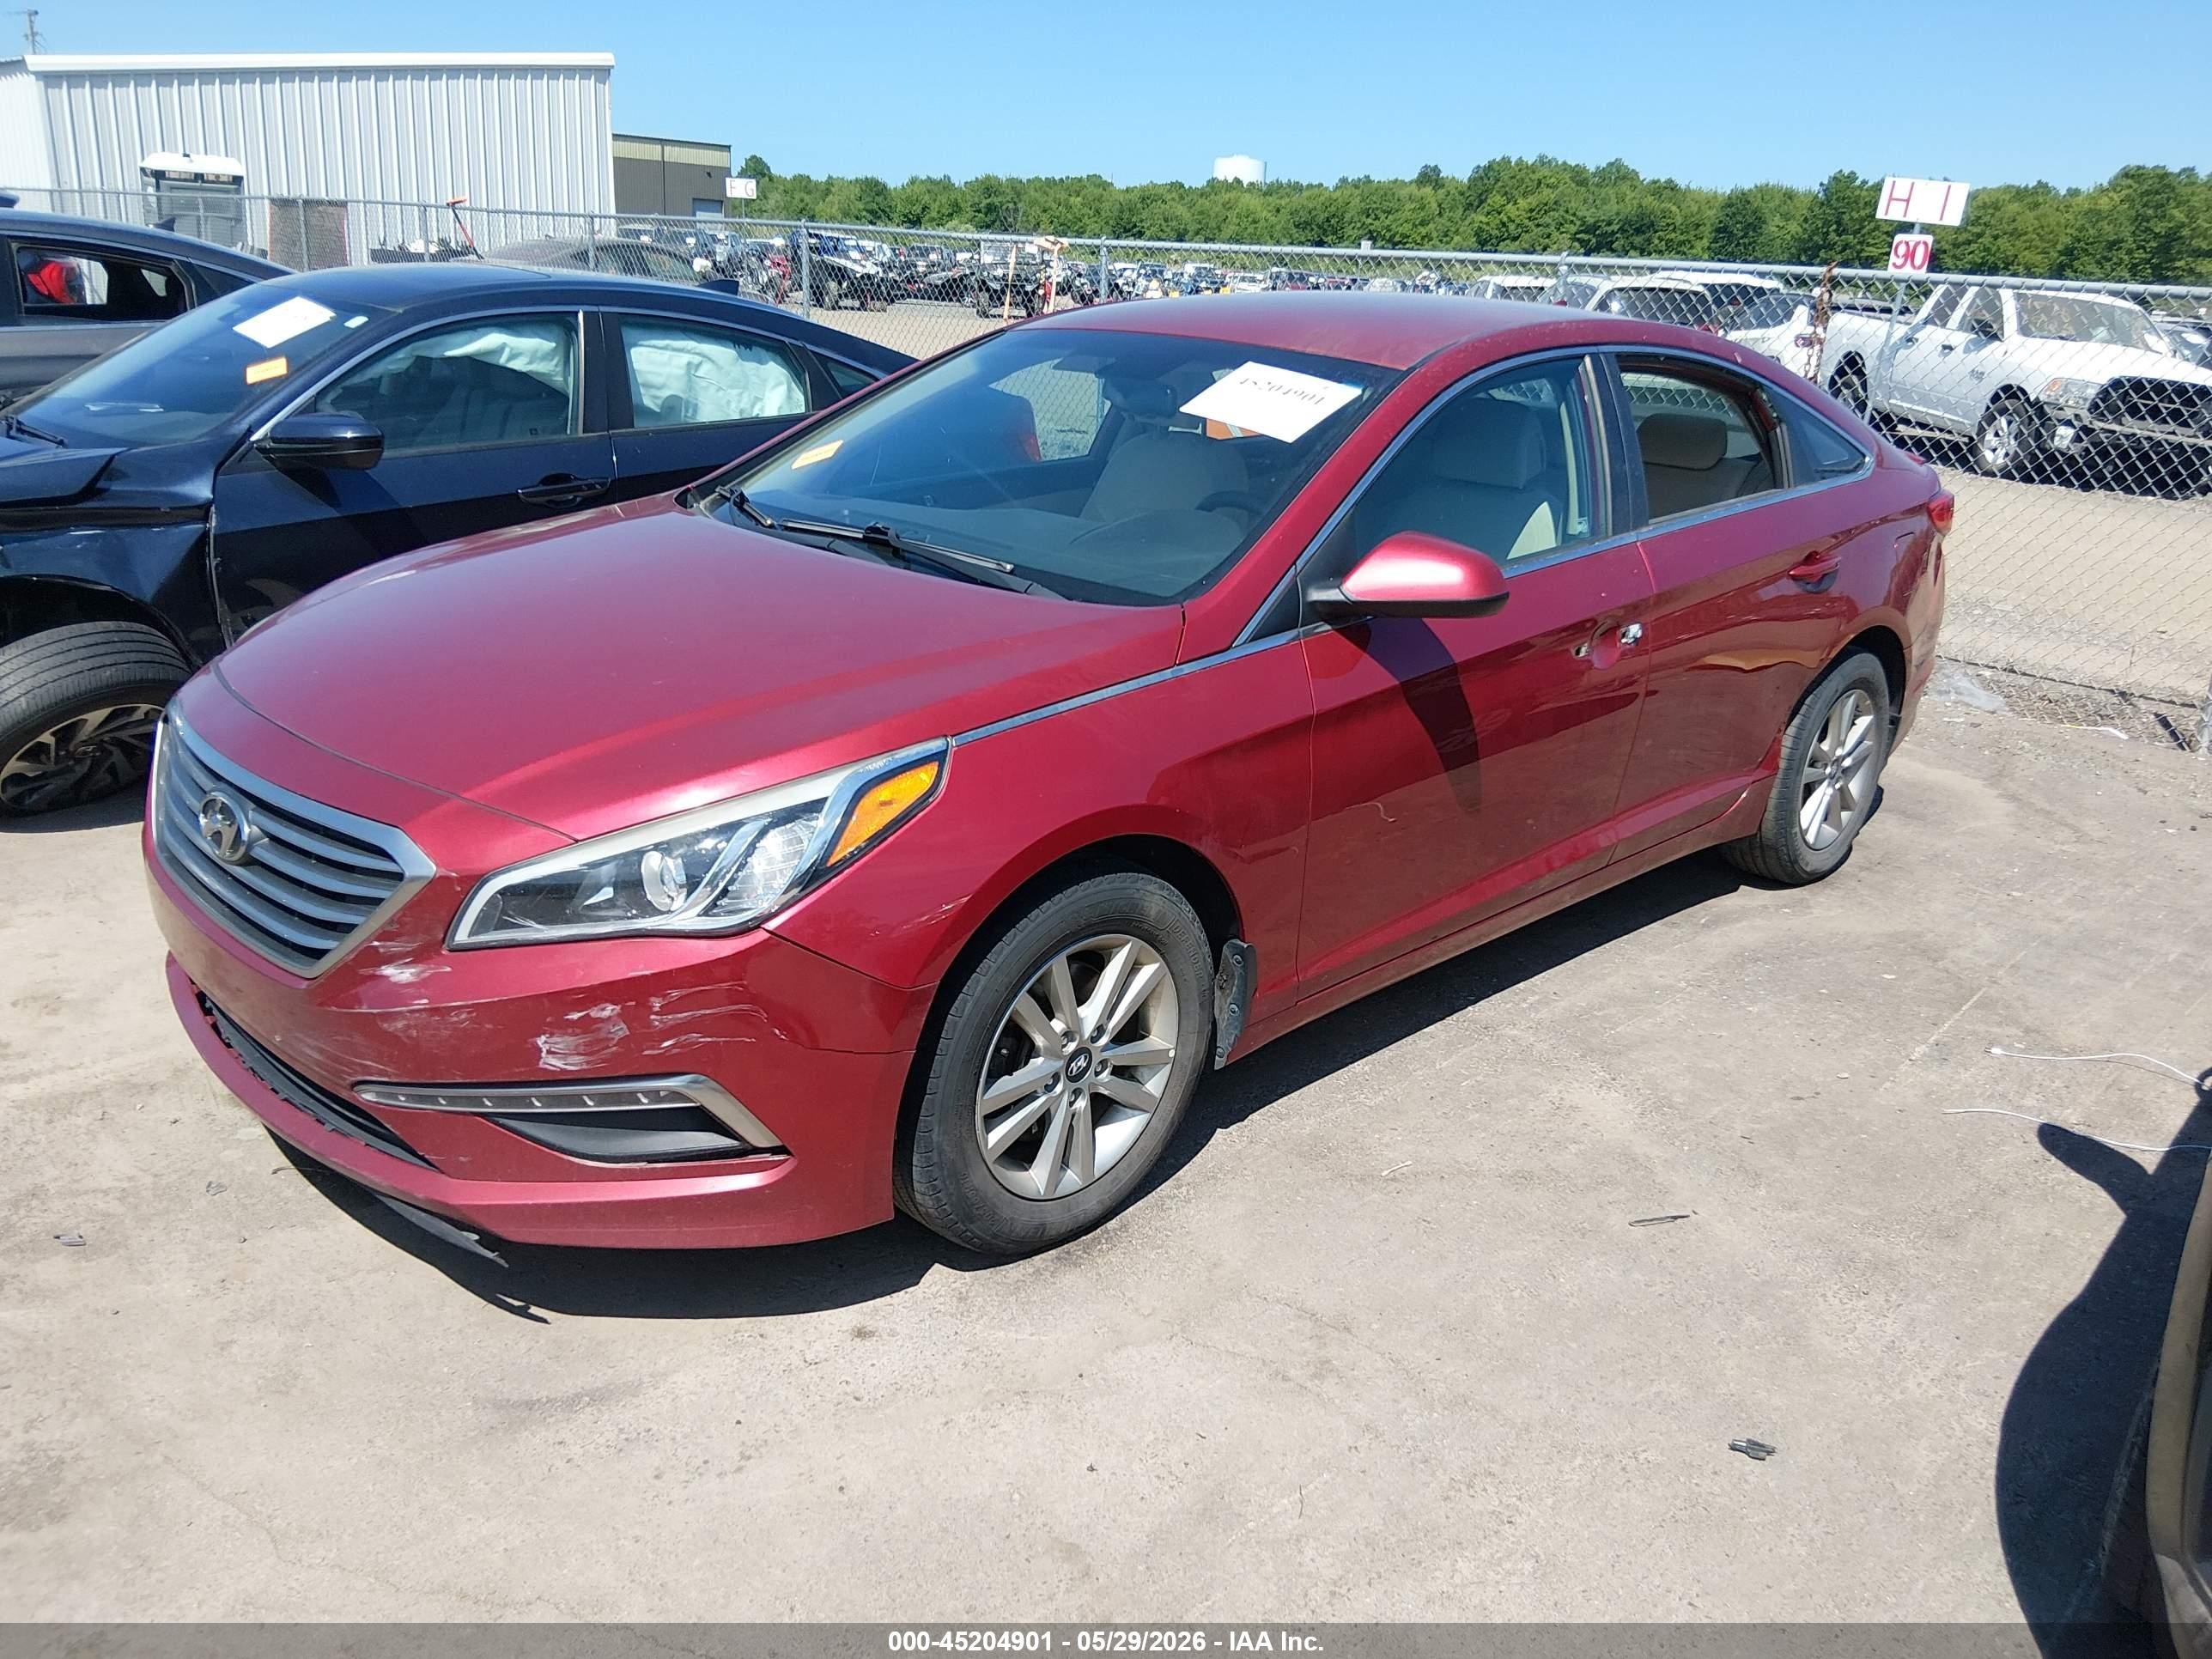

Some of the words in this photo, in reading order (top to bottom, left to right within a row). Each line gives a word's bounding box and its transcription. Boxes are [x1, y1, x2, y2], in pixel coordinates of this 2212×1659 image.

[729, 179, 736, 197] F
[744, 180, 755, 198] G
[1884, 180, 1915, 217] H
[1892, 240, 1929, 270] 90
